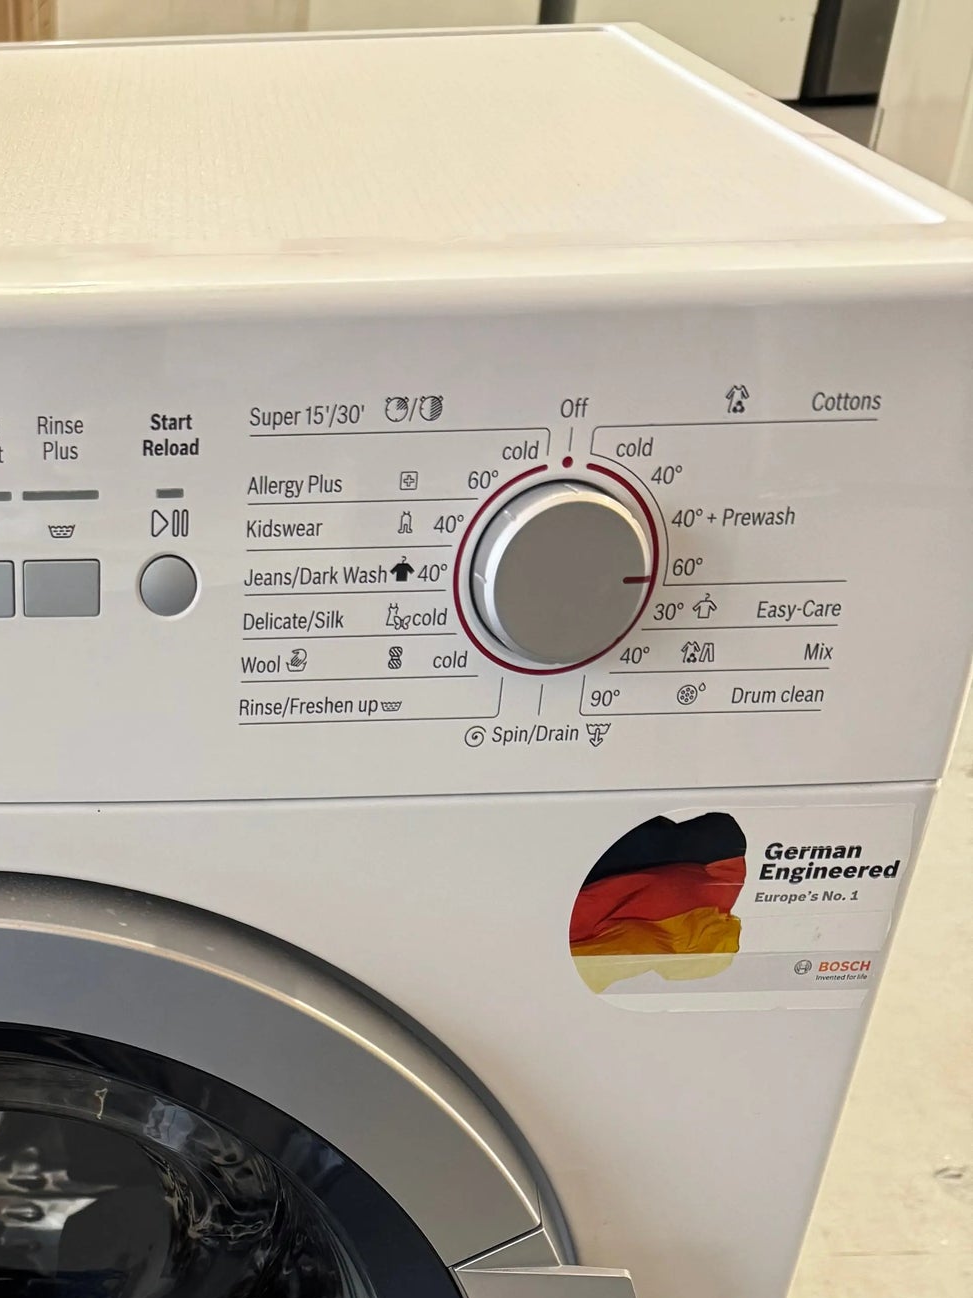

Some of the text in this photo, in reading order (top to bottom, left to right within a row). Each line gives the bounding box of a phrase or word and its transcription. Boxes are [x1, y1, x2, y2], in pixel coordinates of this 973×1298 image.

[560, 398, 588, 418] Off
[812, 392, 881, 411] Cottons
[37, 416, 84, 435] Rinse
[151, 414, 193, 431] Start
[249, 403, 365, 429] Super 15'/30'
[43, 442, 78, 460] Plus
[143, 438, 199, 457] Reload
[502, 441, 539, 461] cold
[616, 437, 653, 458] cold
[468, 470, 499, 490] 60°
[651, 465, 683, 485] 40°
[247, 475, 343, 498] Allergy Plus
[433, 515, 464, 534] 40°
[671, 509, 703, 528] 40°
[722, 507, 795, 526] Prewash
[246, 520, 323, 538] Kidswear
[244, 565, 387, 587] Jeans/Dark Wash
[417, 564, 448, 583] 40°
[672, 558, 703, 576] 60°
[413, 609, 448, 626] cold
[653, 602, 684, 621] 30°
[756, 601, 841, 622] Easy-Care
[243, 611, 344, 632] Delicate/Silk
[433, 651, 468, 669] cold
[619, 646, 650, 664] 40°
[804, 644, 833, 661] Mix
[241, 656, 280, 674] Wool
[590, 689, 620, 708] 90°
[731, 687, 825, 704] Drum clean
[239, 697, 378, 718] Rinse/Freshen up
[492, 725, 579, 746] Spin/Drain
[765, 842, 862, 860] German
[759, 860, 900, 884] Engineered
[822, 891, 846, 901] No.
[850, 891, 858, 900] 1
[818, 961, 871, 972] BOSCH
